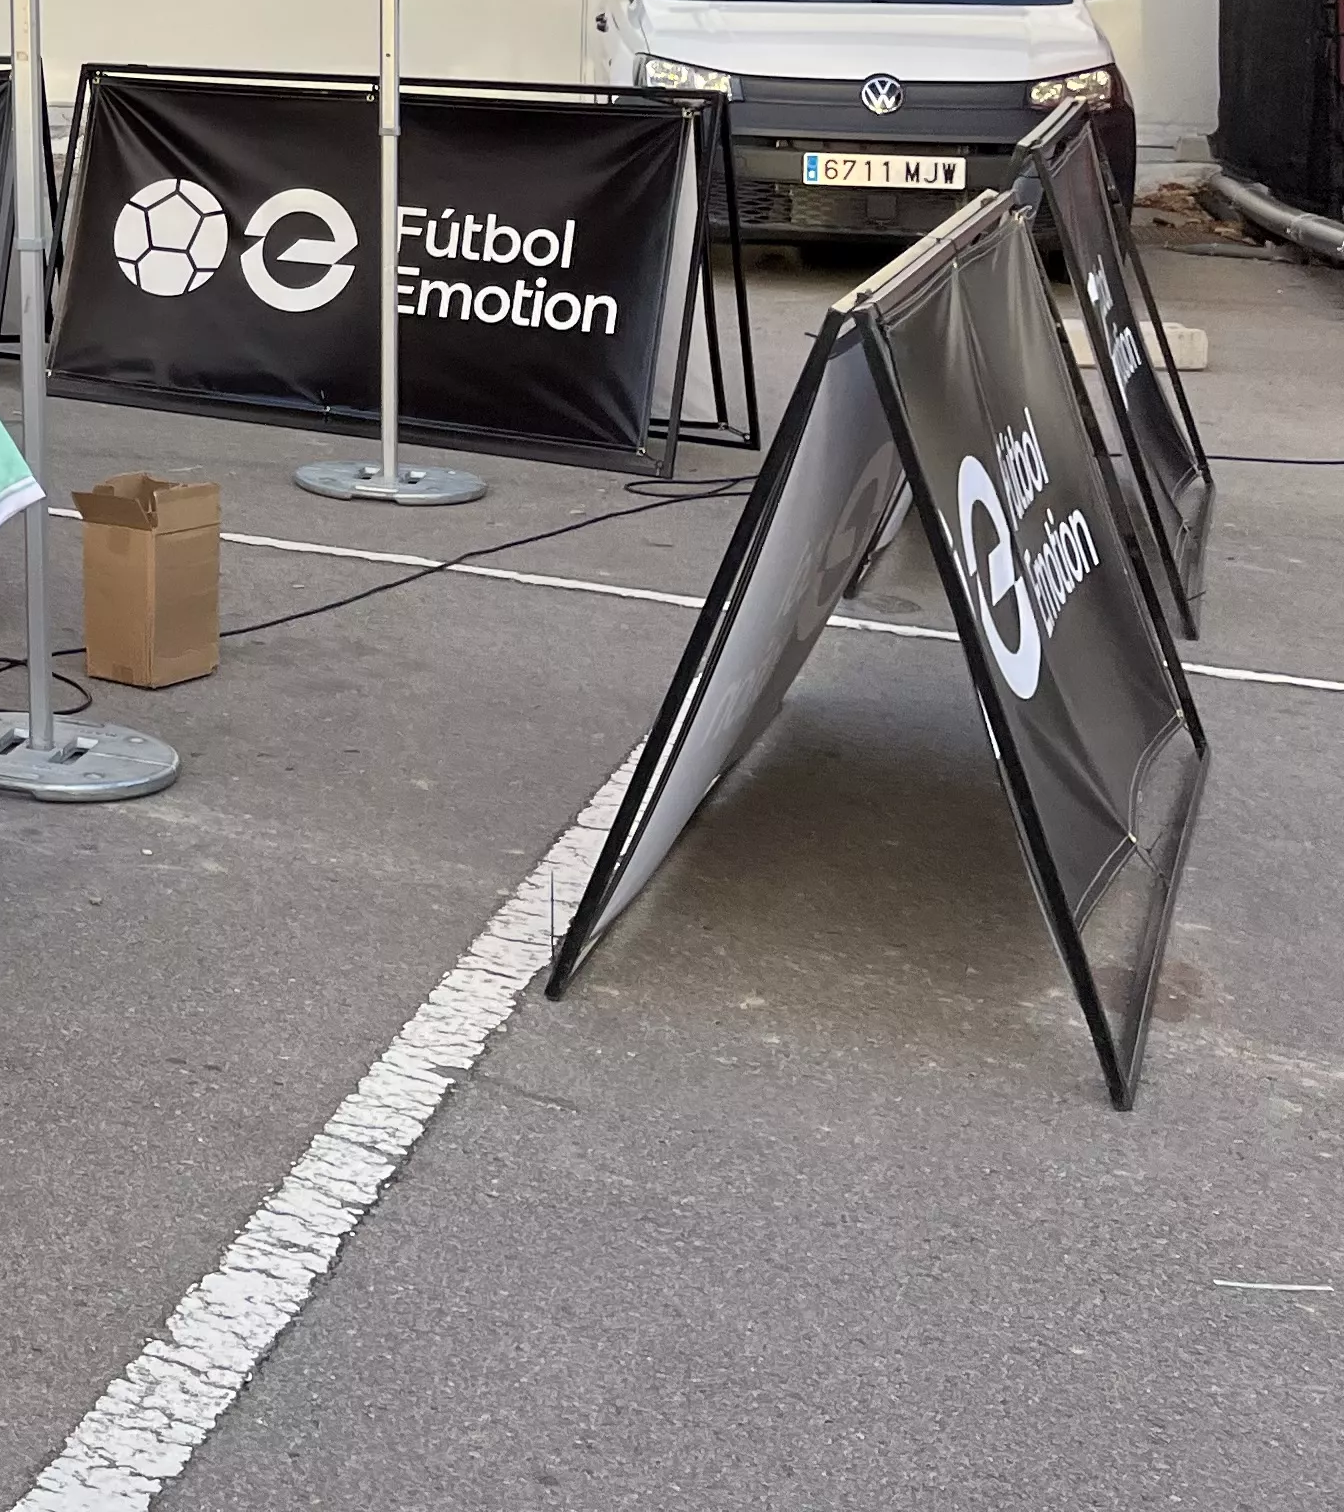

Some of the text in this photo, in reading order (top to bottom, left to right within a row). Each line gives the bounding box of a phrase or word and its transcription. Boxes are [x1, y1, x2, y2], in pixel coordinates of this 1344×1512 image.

[824, 159, 956, 185] 6711 MJW
[397, 206, 576, 269] Fútbol
[397, 265, 619, 335] Emotion
